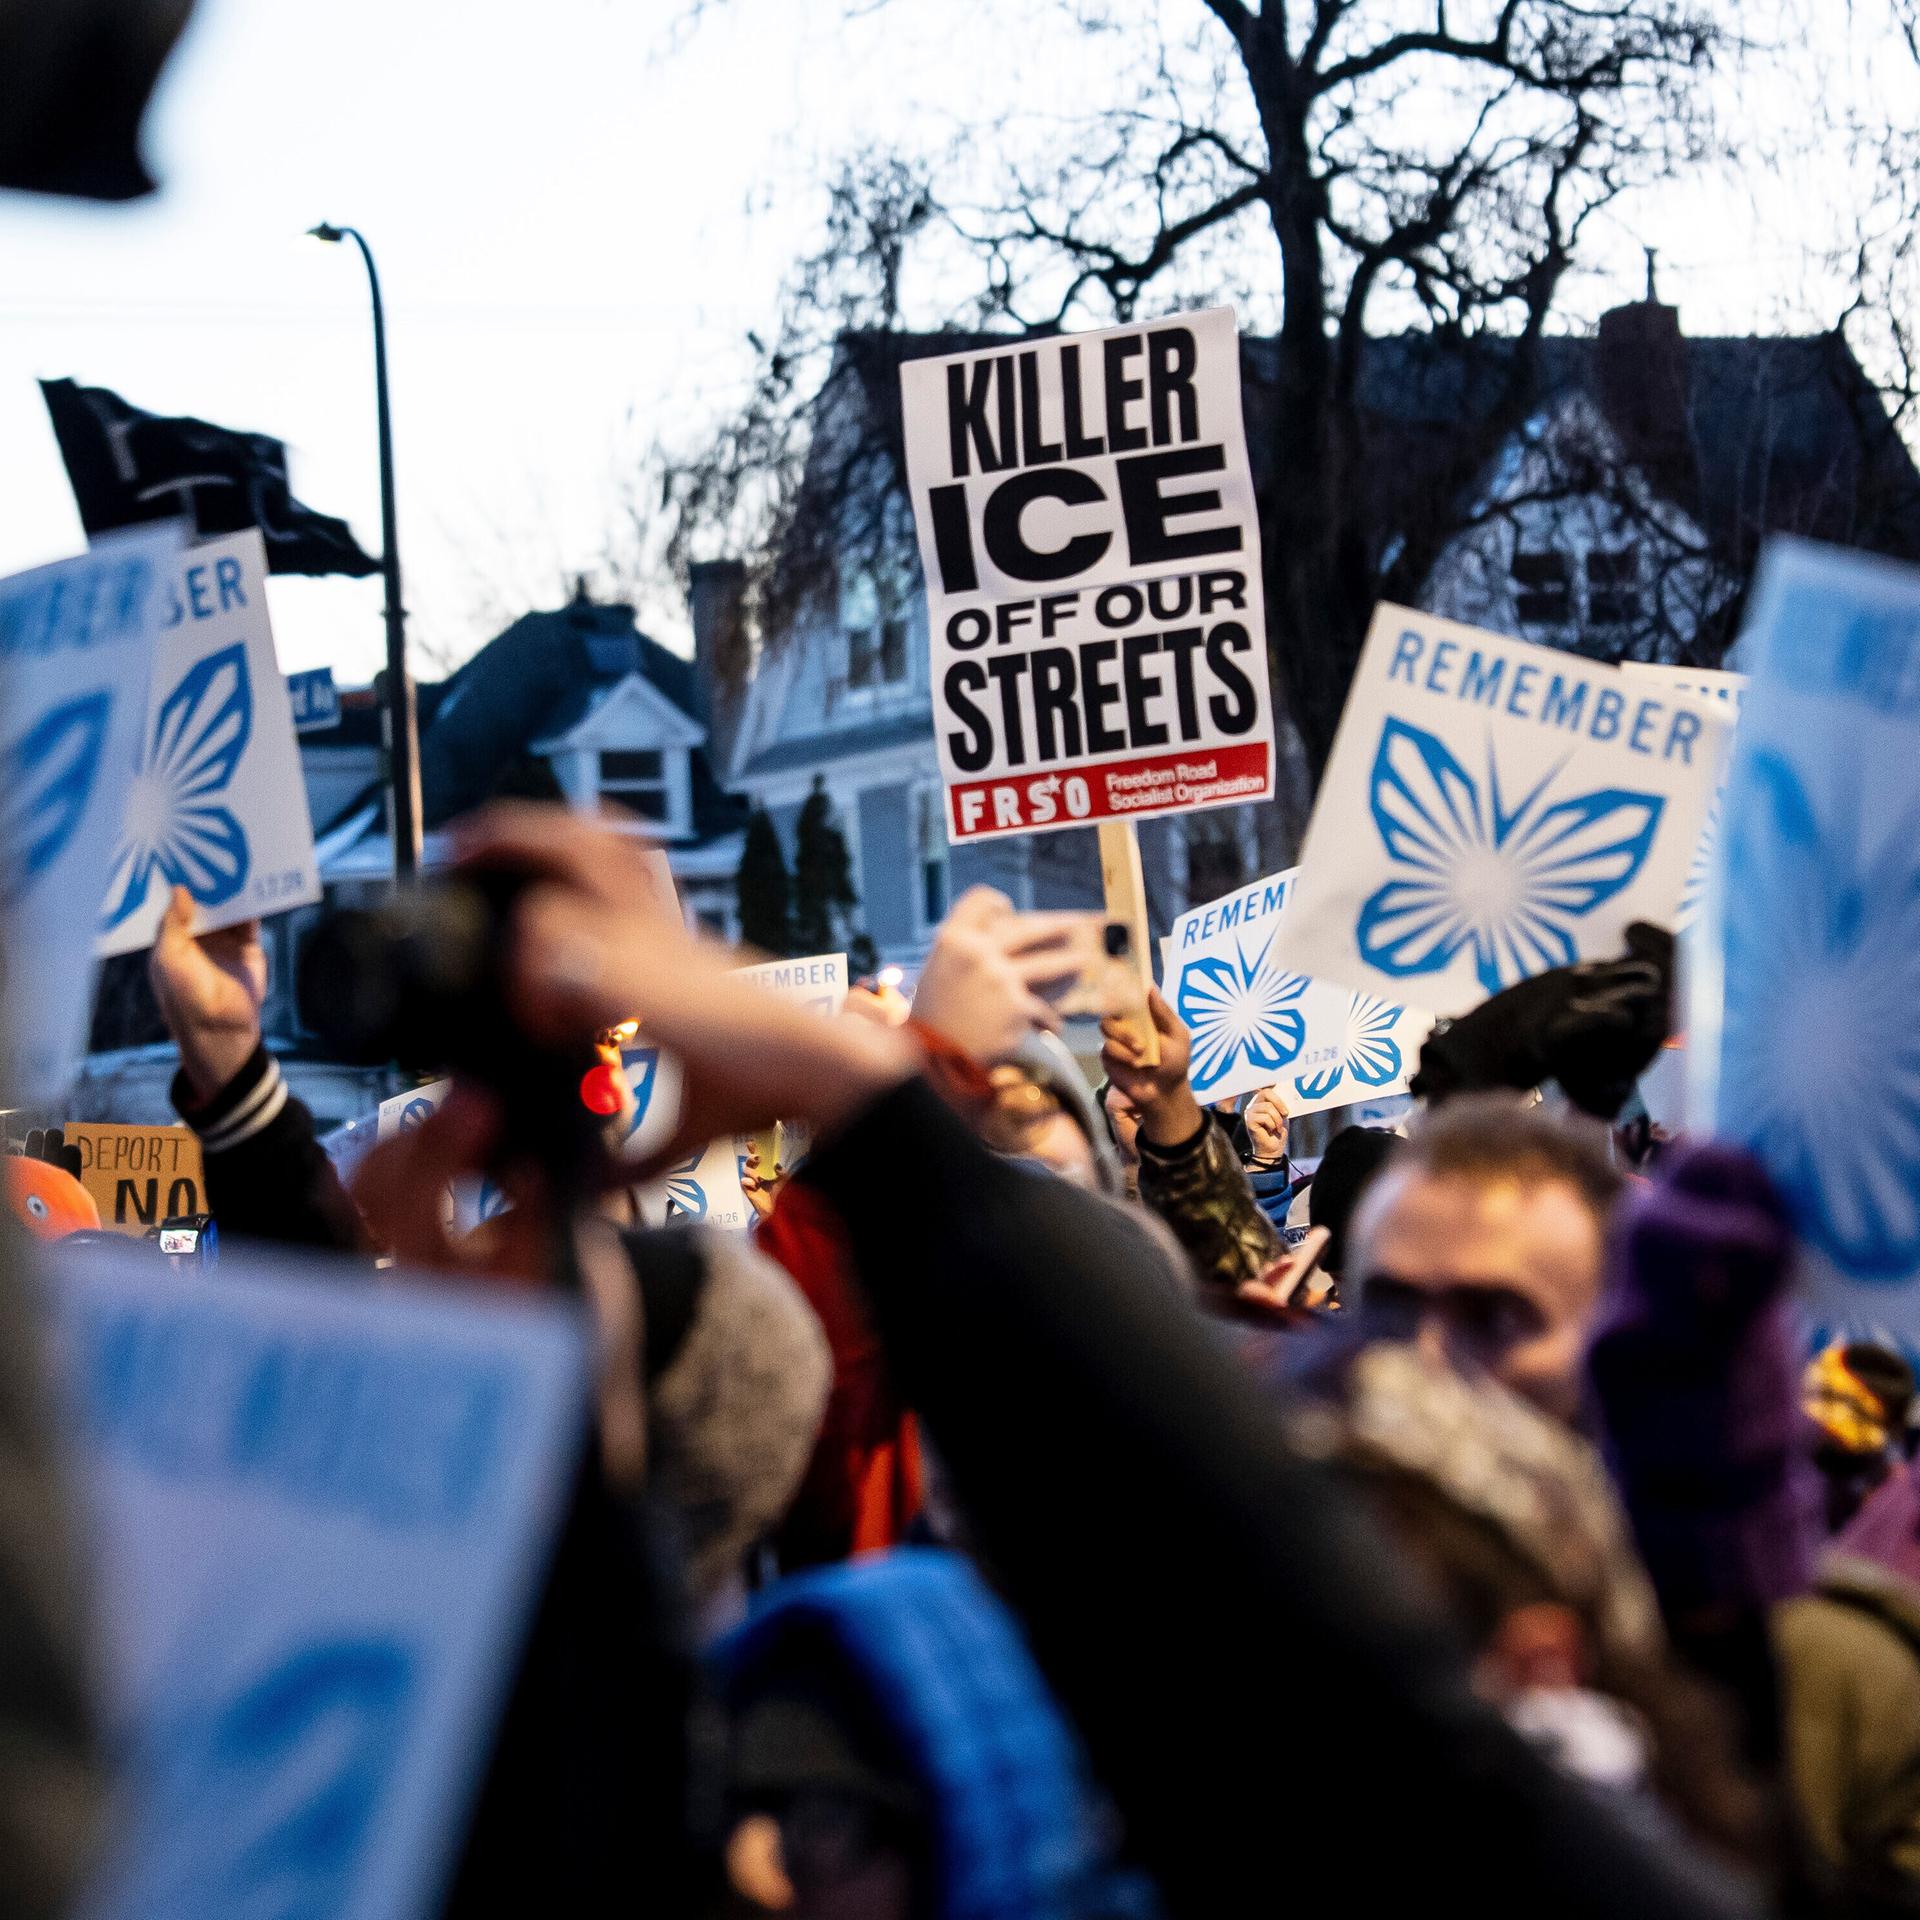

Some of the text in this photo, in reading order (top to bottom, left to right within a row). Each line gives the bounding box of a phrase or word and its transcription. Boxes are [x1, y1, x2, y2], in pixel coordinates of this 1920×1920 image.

[947, 327, 1199, 478] KILLER
[929, 443, 1243, 594] ICE
[946, 570, 1248, 651] OFF OUR
[944, 621, 1258, 773] STREETS
[1387, 629, 1702, 766] REMEMBER
[1106, 759, 1218, 791] Freedom Road
[1108, 775, 1265, 810] Socialist Organization
[77, 1136, 187, 1172] DEPORT
